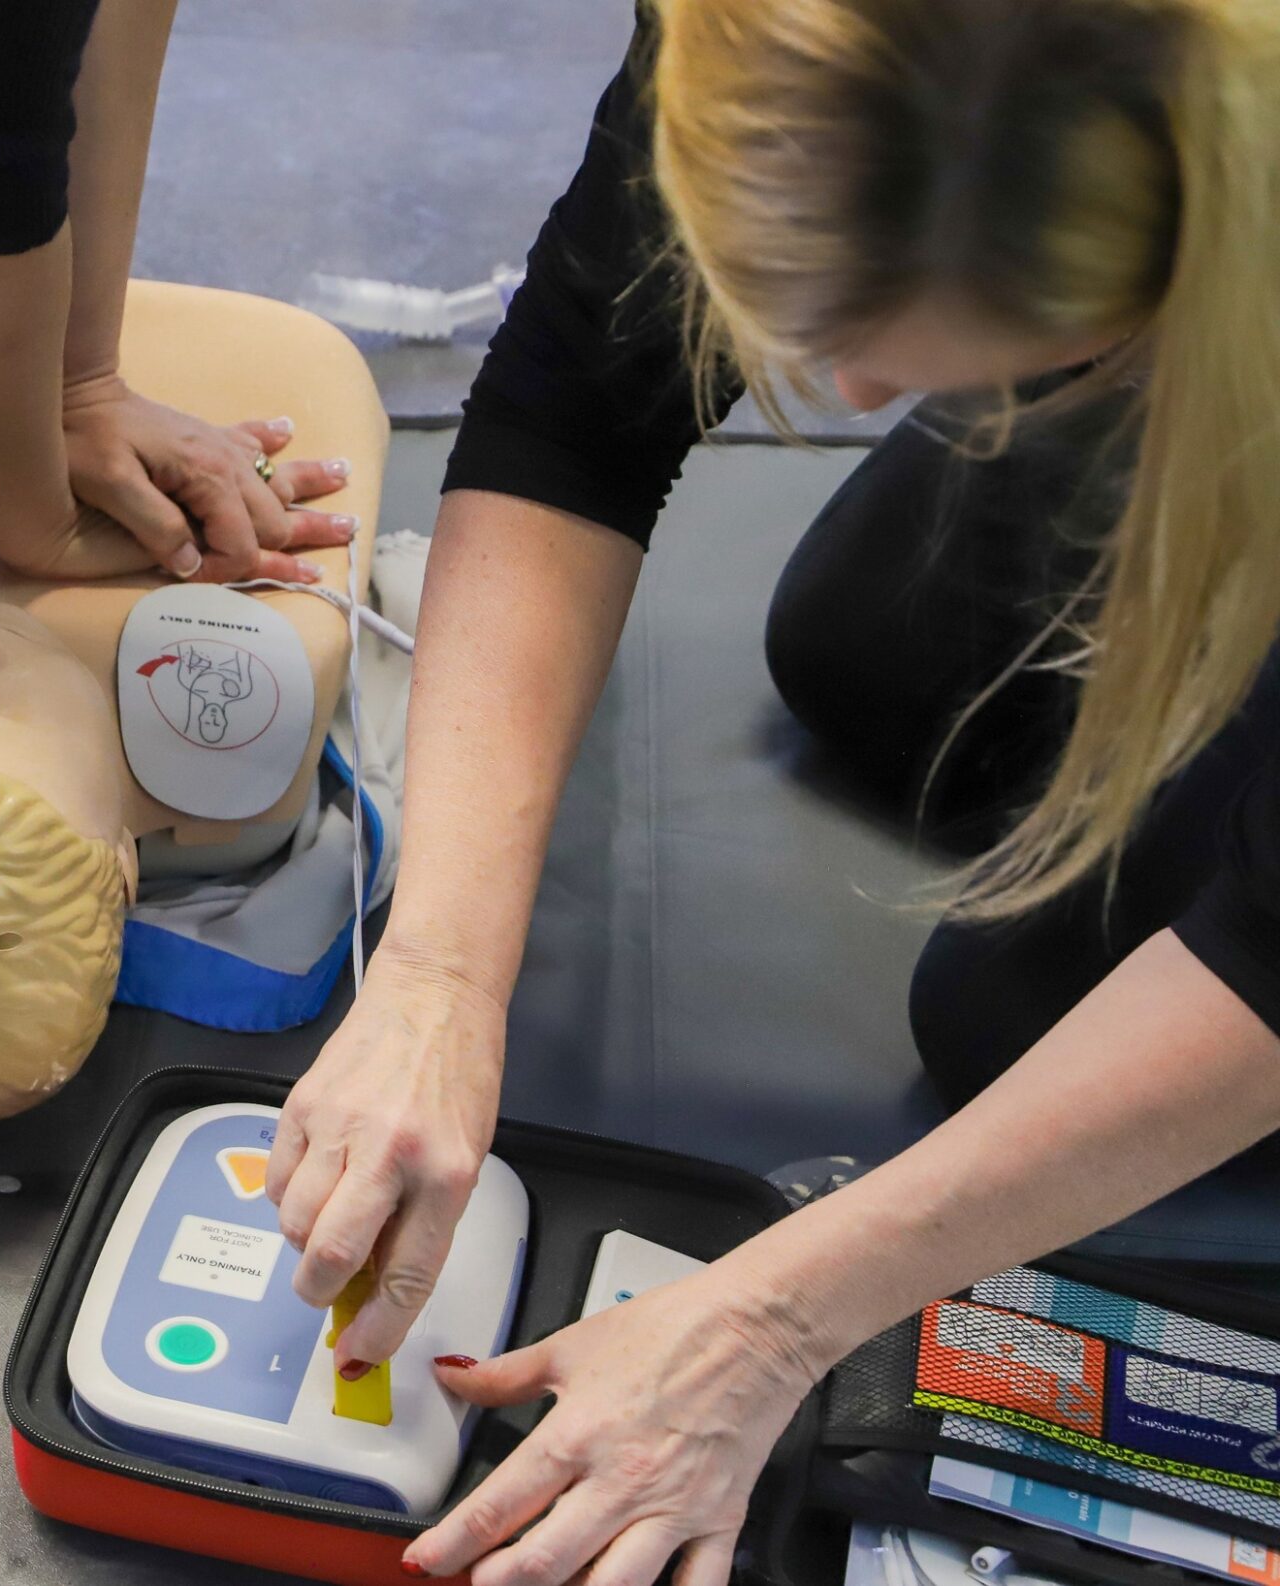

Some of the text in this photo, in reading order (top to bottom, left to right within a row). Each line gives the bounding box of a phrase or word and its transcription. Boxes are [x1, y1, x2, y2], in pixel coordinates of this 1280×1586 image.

[159, 615, 260, 632] TRAINING ONLY
[200, 1224, 263, 1243] CLINICAL USE
[208, 1234, 251, 1248] NOT FOR
[176, 1252, 263, 1278] TRAINING ONLY
[269, 1354, 282, 1373] 1
[1055, 1379, 1097, 1423] 3
